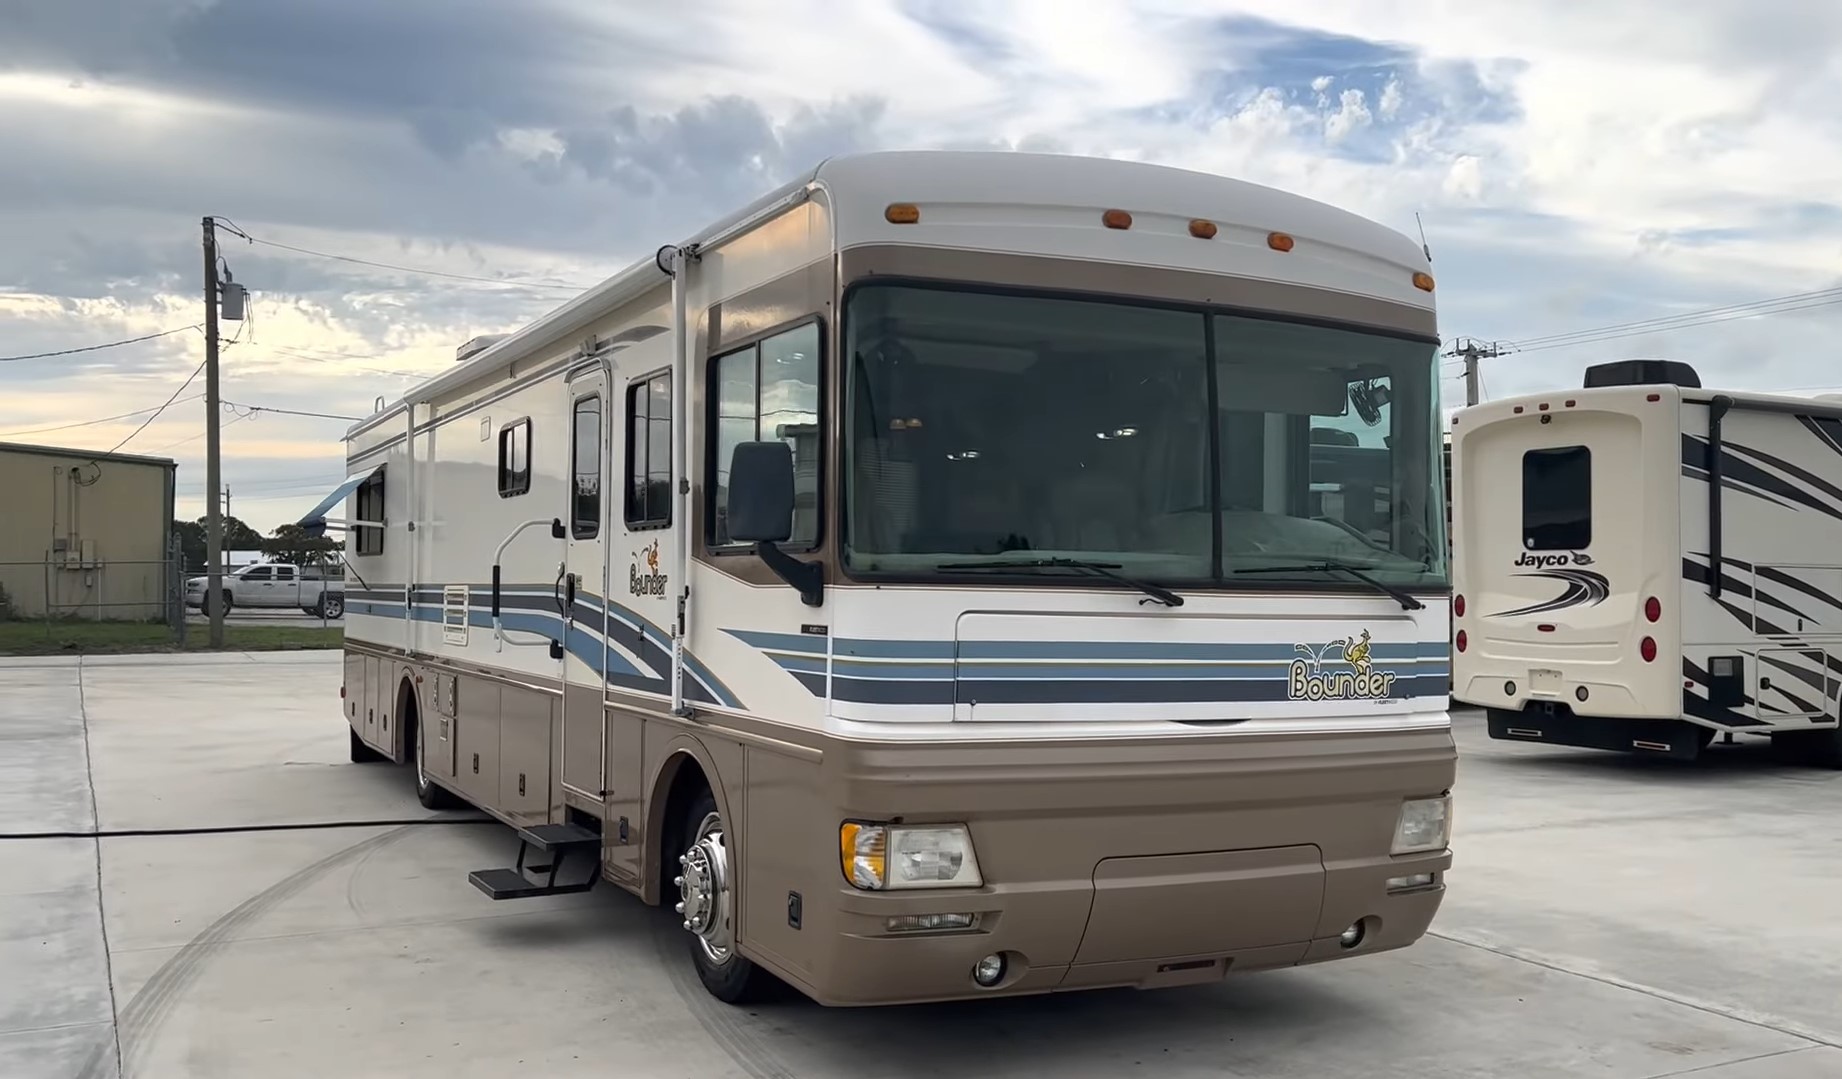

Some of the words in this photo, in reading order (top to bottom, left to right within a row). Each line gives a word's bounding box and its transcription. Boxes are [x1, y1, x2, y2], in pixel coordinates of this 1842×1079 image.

[1514, 552, 1568, 569] Jayco
[630, 563, 668, 597] Bounder
[1289, 658, 1396, 702] Bounder
